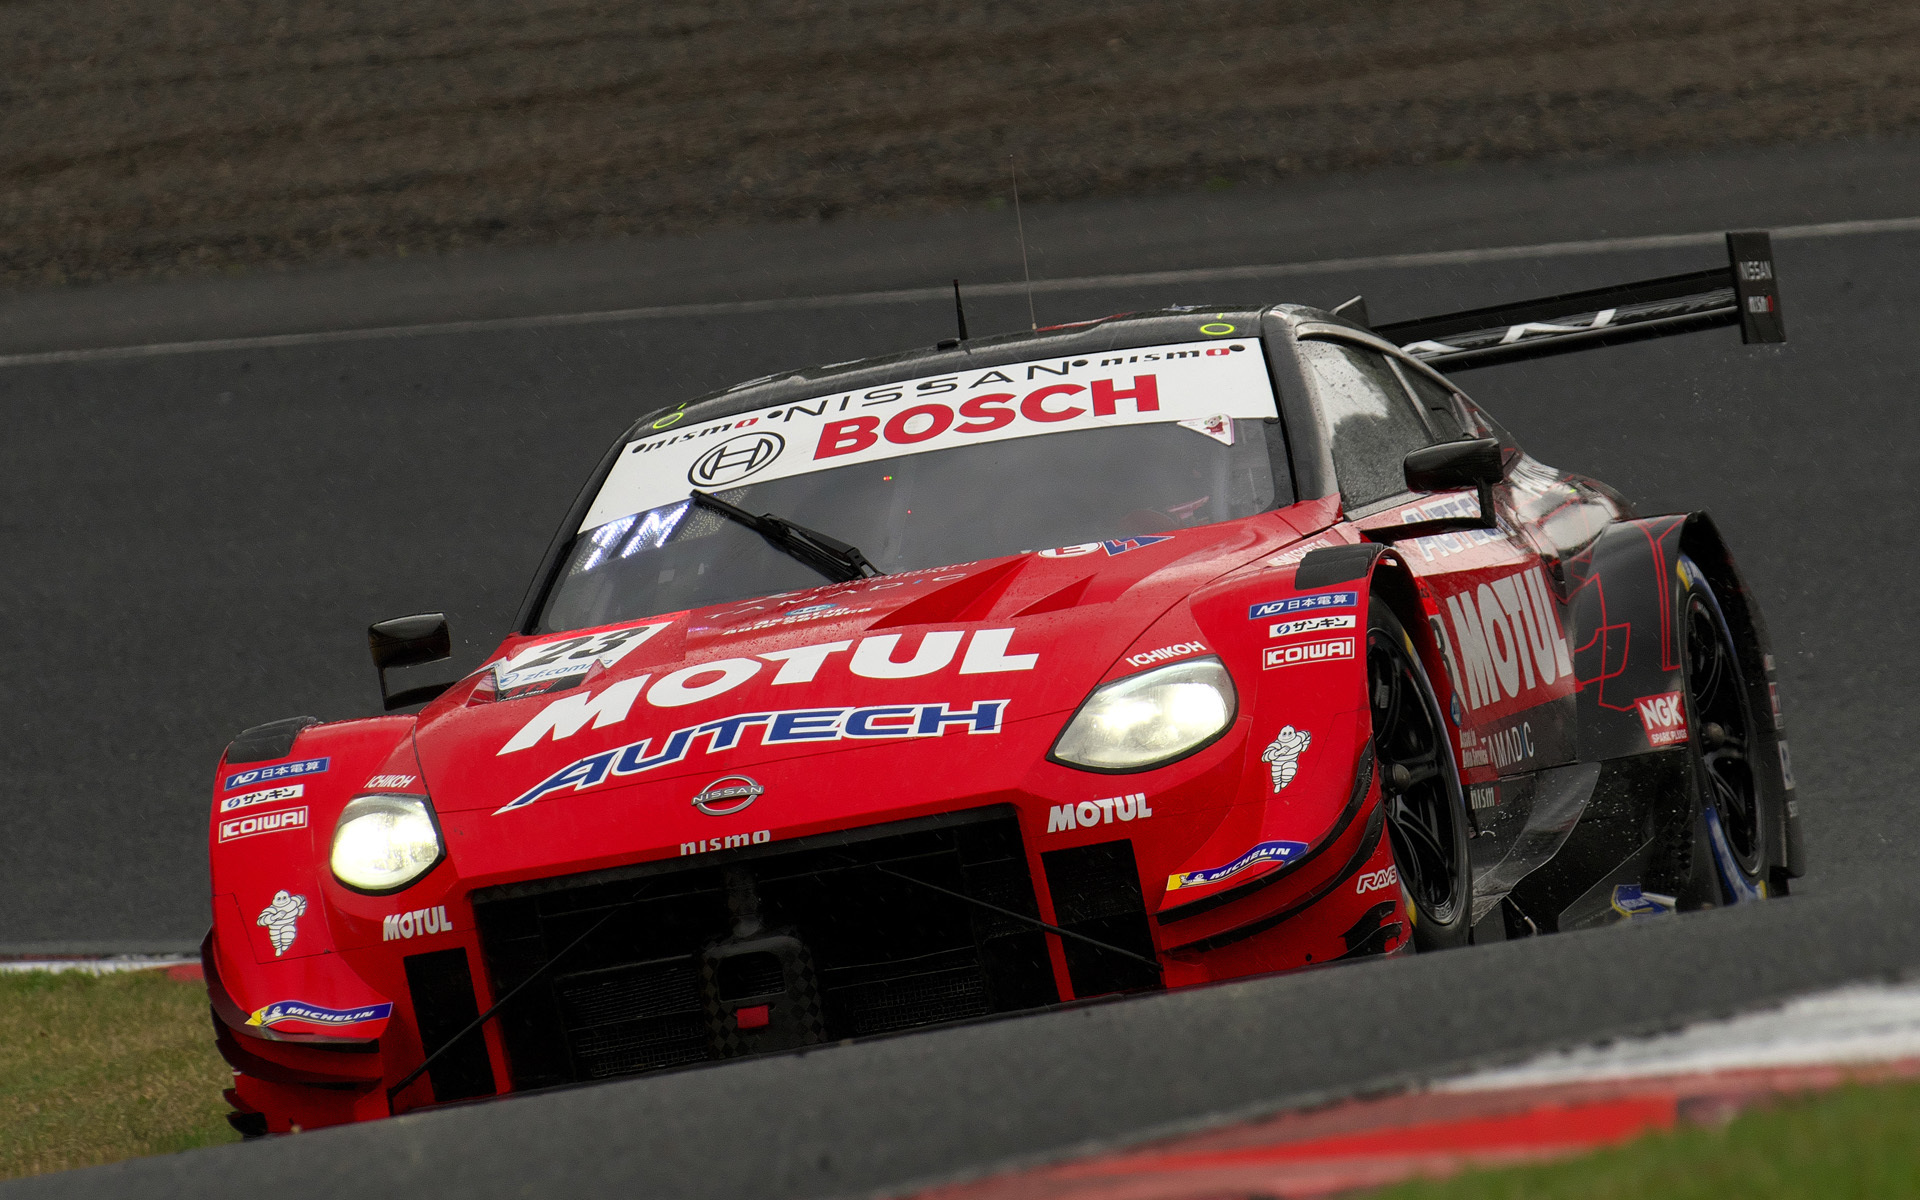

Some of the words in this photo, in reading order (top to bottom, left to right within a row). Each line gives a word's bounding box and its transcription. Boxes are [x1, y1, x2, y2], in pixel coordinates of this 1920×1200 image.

[1100, 346, 1231, 368] nismo
[784, 360, 1070, 423] NISSAN
[813, 374, 1160, 460] BOSCH
[644, 416, 759, 454] nismo
[1287, 594, 1348, 611] 日本電算
[1293, 616, 1349, 631] サンキン
[1445, 566, 1573, 710] MOTUL
[506, 626, 651, 675] 23
[1125, 640, 1207, 668] ICHIKOH
[1267, 640, 1352, 666] KOIWAI
[496, 627, 1040, 756] MOTUL
[1639, 694, 1684, 730] NGK
[260, 760, 320, 780] 日本電算
[491, 699, 1012, 817] AUTECH
[243, 786, 296, 804] サンキン
[363, 774, 416, 789] ICHIKOH
[693, 786, 762, 804] NISSAN
[222, 808, 305, 838] KOIWAI
[1047, 793, 1152, 833] MOTUL
[680, 829, 771, 856] nismo
[1210, 846, 1291, 880] MICHELIN
[1356, 864, 1397, 894] RAYS
[382, 905, 453, 941] MOTUL
[286, 1006, 375, 1022] MICHELIN
